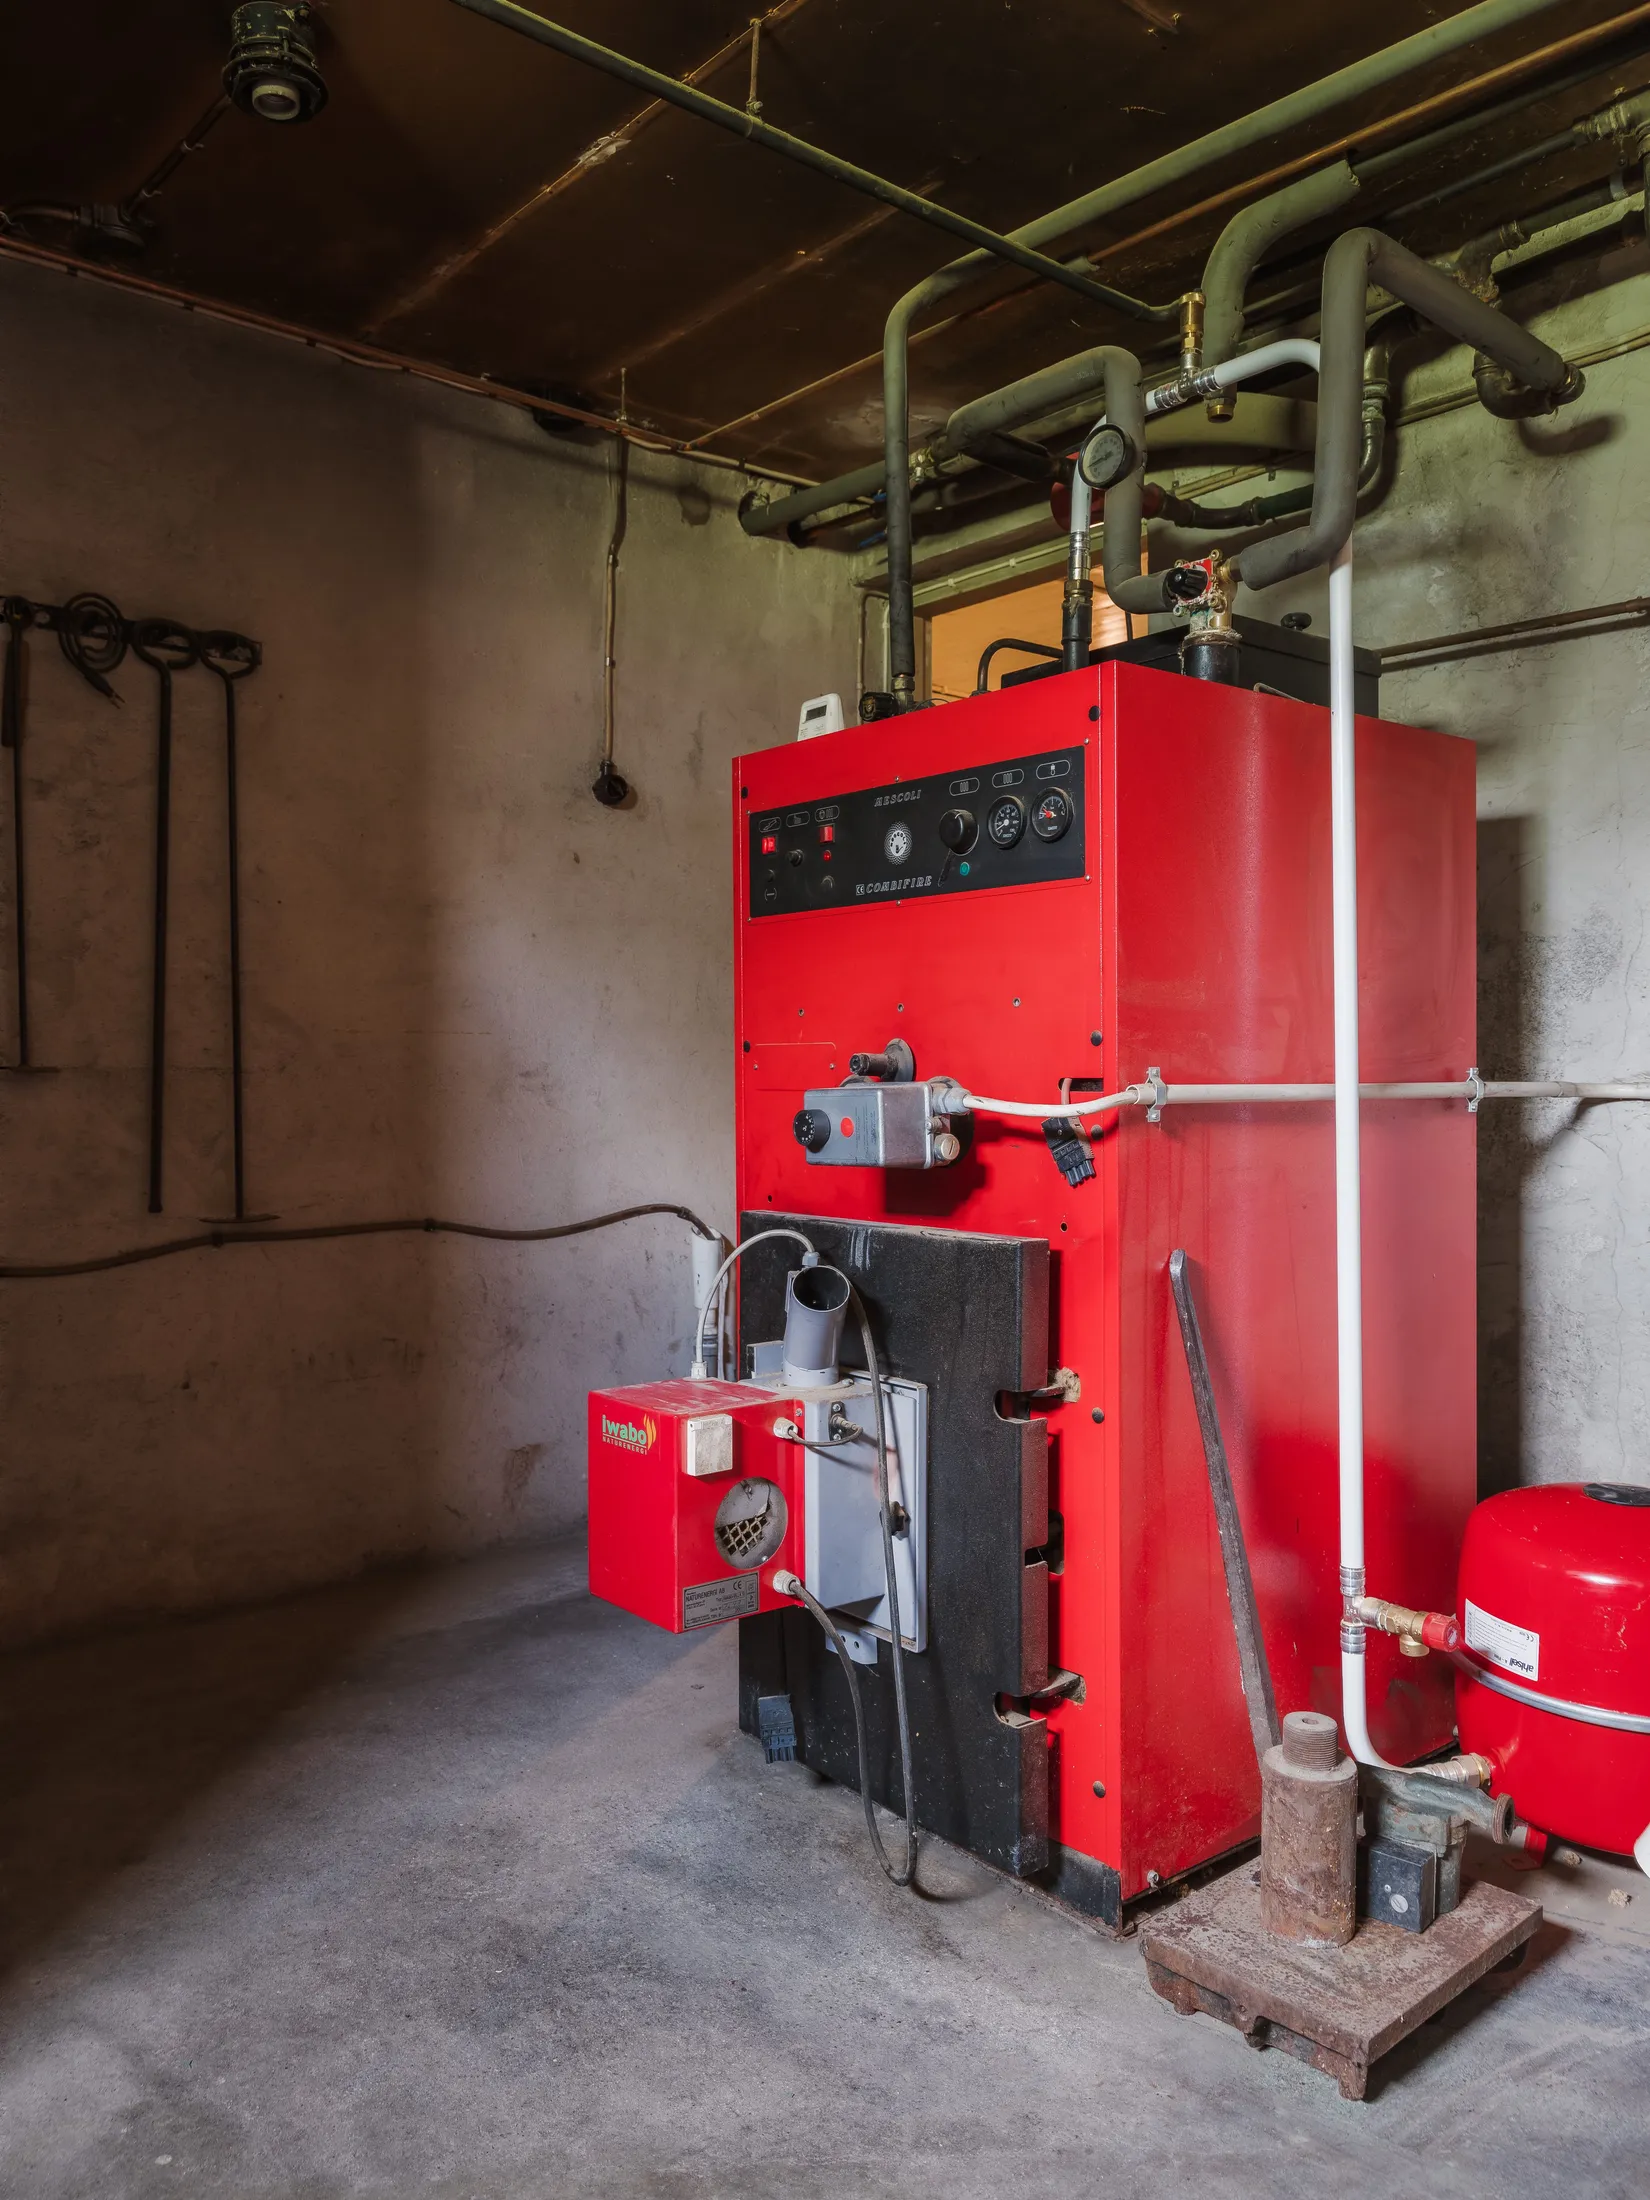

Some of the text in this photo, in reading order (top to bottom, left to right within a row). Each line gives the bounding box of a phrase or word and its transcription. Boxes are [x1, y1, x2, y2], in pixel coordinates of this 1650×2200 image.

[874, 790, 922, 807] MESCOLI
[866, 875, 932, 894] COMBIFIRE
[602, 1414, 647, 1445] iwabo
[602, 1436, 648, 1455] NATURENERGI
[1509, 1657, 1534, 1673] ahlsell
